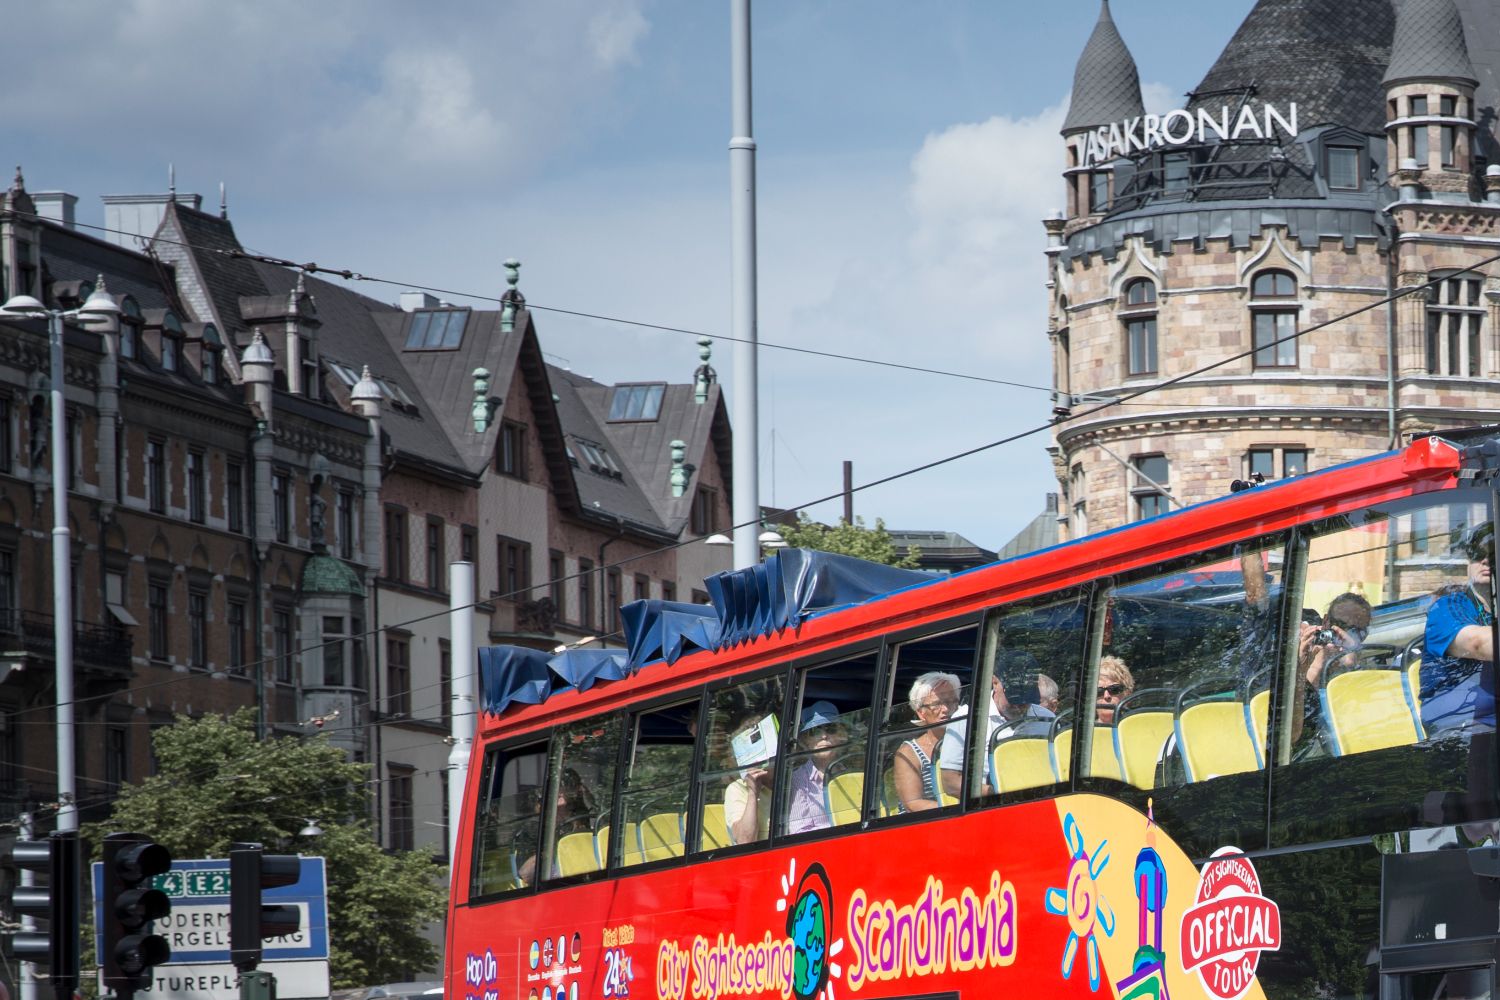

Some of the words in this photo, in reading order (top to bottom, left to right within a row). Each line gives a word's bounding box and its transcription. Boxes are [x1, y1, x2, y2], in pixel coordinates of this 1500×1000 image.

[1074, 101, 1298, 168] VASAKRONAN
[1215, 859, 1258, 894] SIGHTSEEING
[847, 869, 1018, 992] Scandinavia
[1190, 904, 1275, 960] OFFICIAL
[465, 955, 483, 987] Hop
[484, 950, 497, 982] On
[1214, 957, 1254, 994] TOUR
